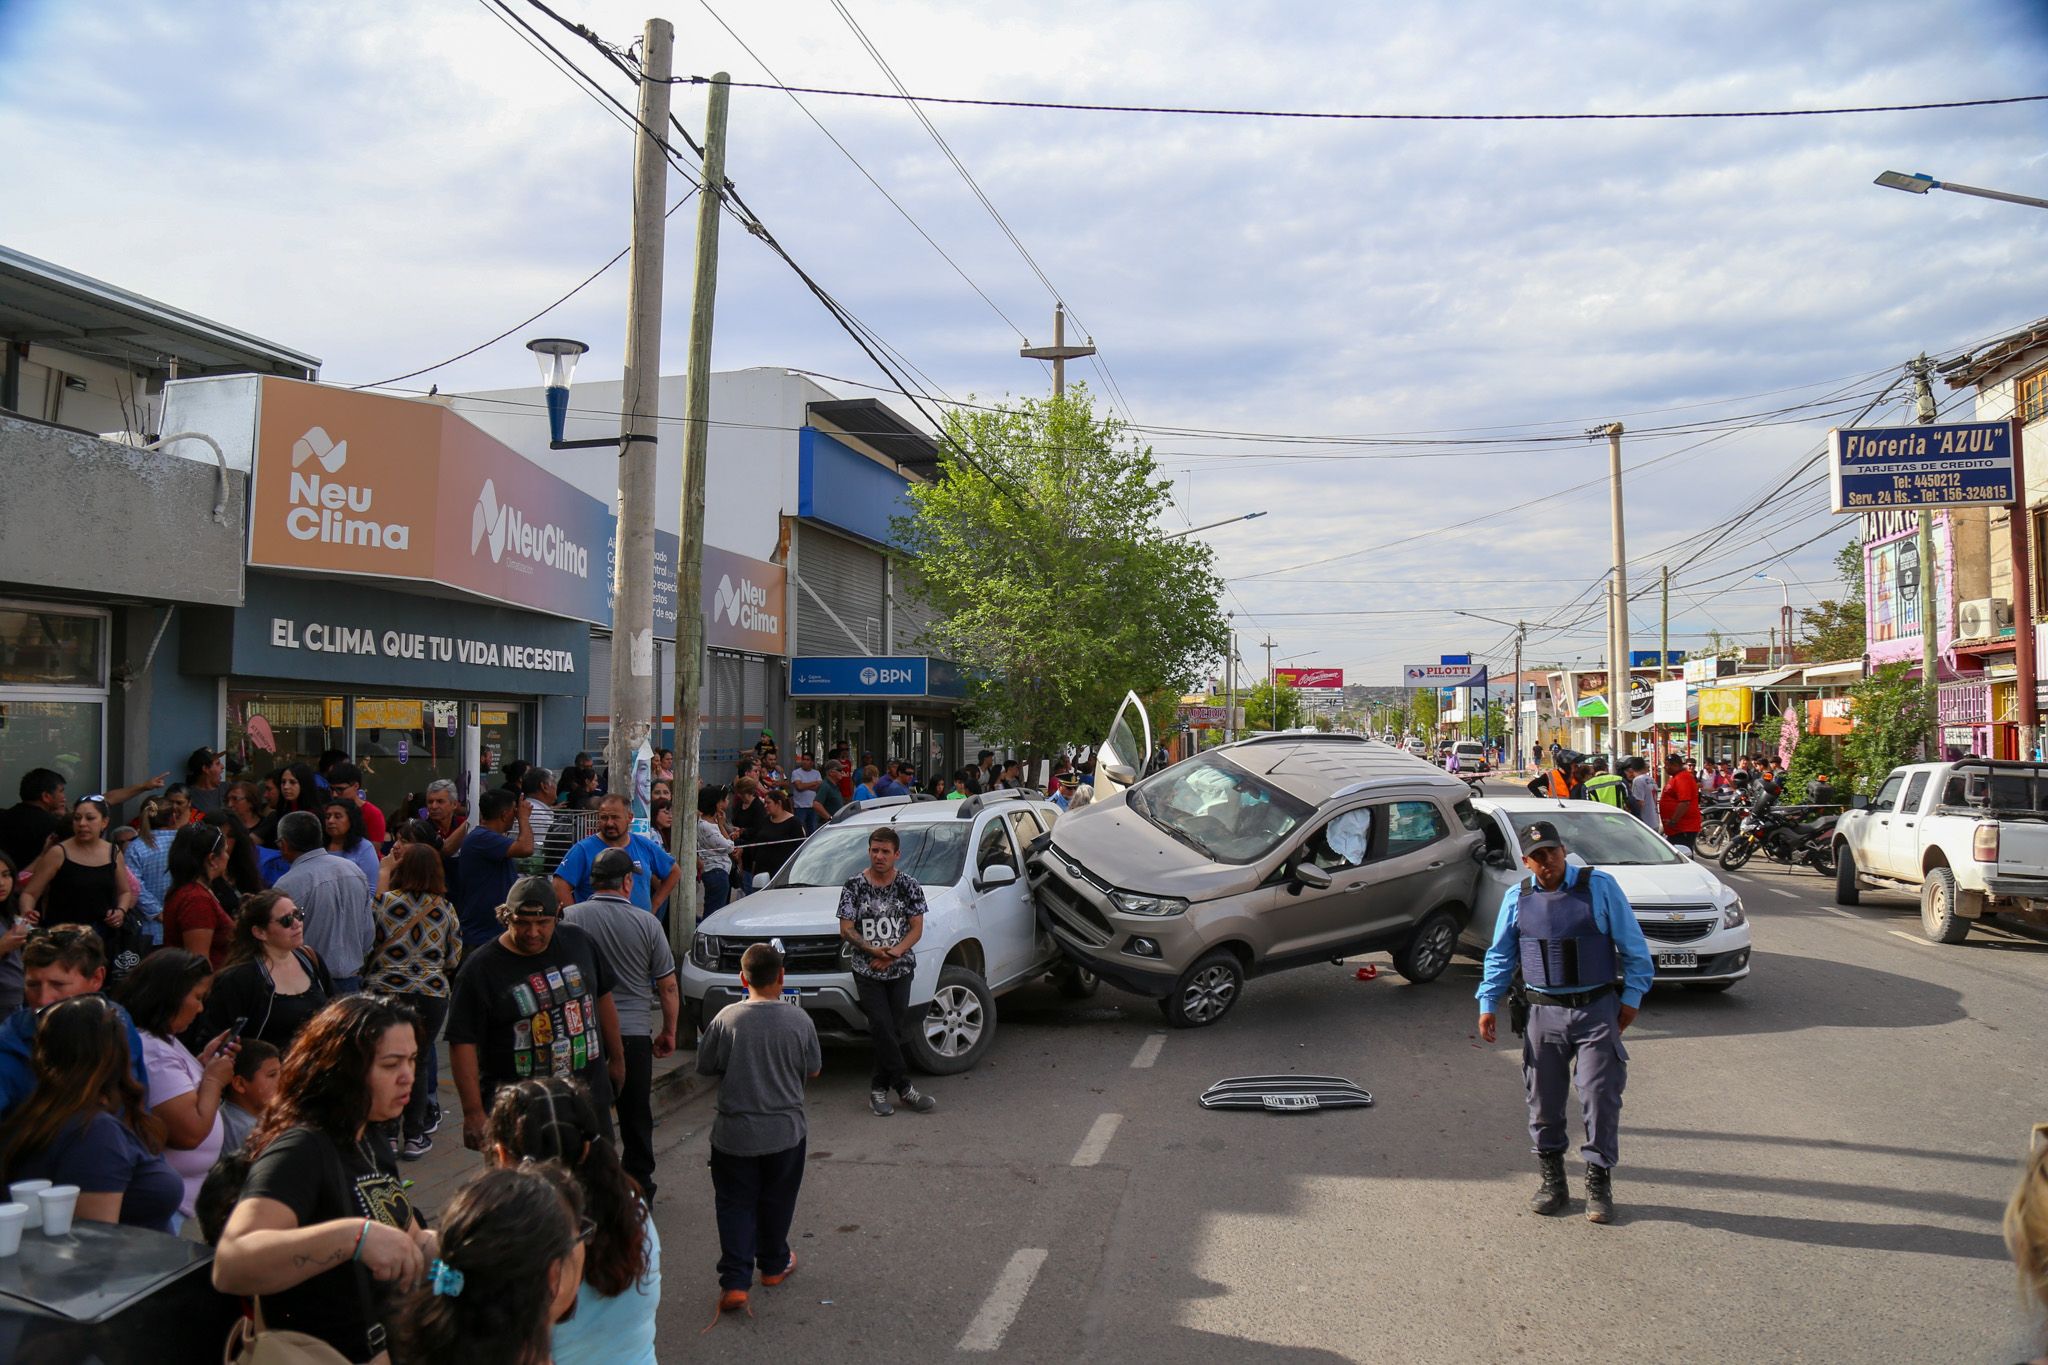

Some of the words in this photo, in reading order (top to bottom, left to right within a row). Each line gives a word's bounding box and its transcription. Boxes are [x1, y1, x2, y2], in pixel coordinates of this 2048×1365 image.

[1846, 433, 1926, 458] Floreria
[1857, 463, 1917, 474] TARJETAS
[1921, 462, 1937, 471] DE
[1941, 460, 1994, 470] CREDITO
[289, 471, 373, 512] Neu
[1893, 475, 1912, 489] Tel:
[1914, 473, 1961, 487] 4450212
[1849, 492, 1876, 505] Serv.
[1878, 490, 1892, 504] 24
[1894, 489, 1911, 503] Hs.
[1920, 488, 1940, 502] Tel:
[1942, 485, 2007, 501] 156-324815
[286, 506, 410, 550] Clima
[507, 506, 588, 579] NeuClima
[741, 578, 767, 608] Neu
[740, 604, 778, 634] Clima
[271, 618, 300, 648] EL
[303, 623, 377, 655] CLIMA
[382, 630, 425, 659] QUE
[429, 636, 453, 661] TU
[456, 639, 500, 667] VIDA
[503, 644, 575, 672] NECESITA
[879, 668, 912, 684] BPN
[1426, 666, 1471, 675] PILOTTI
[861, 916, 903, 941] BOY
[1660, 953, 1676, 965] PLG
[1680, 953, 1696, 965] 213
